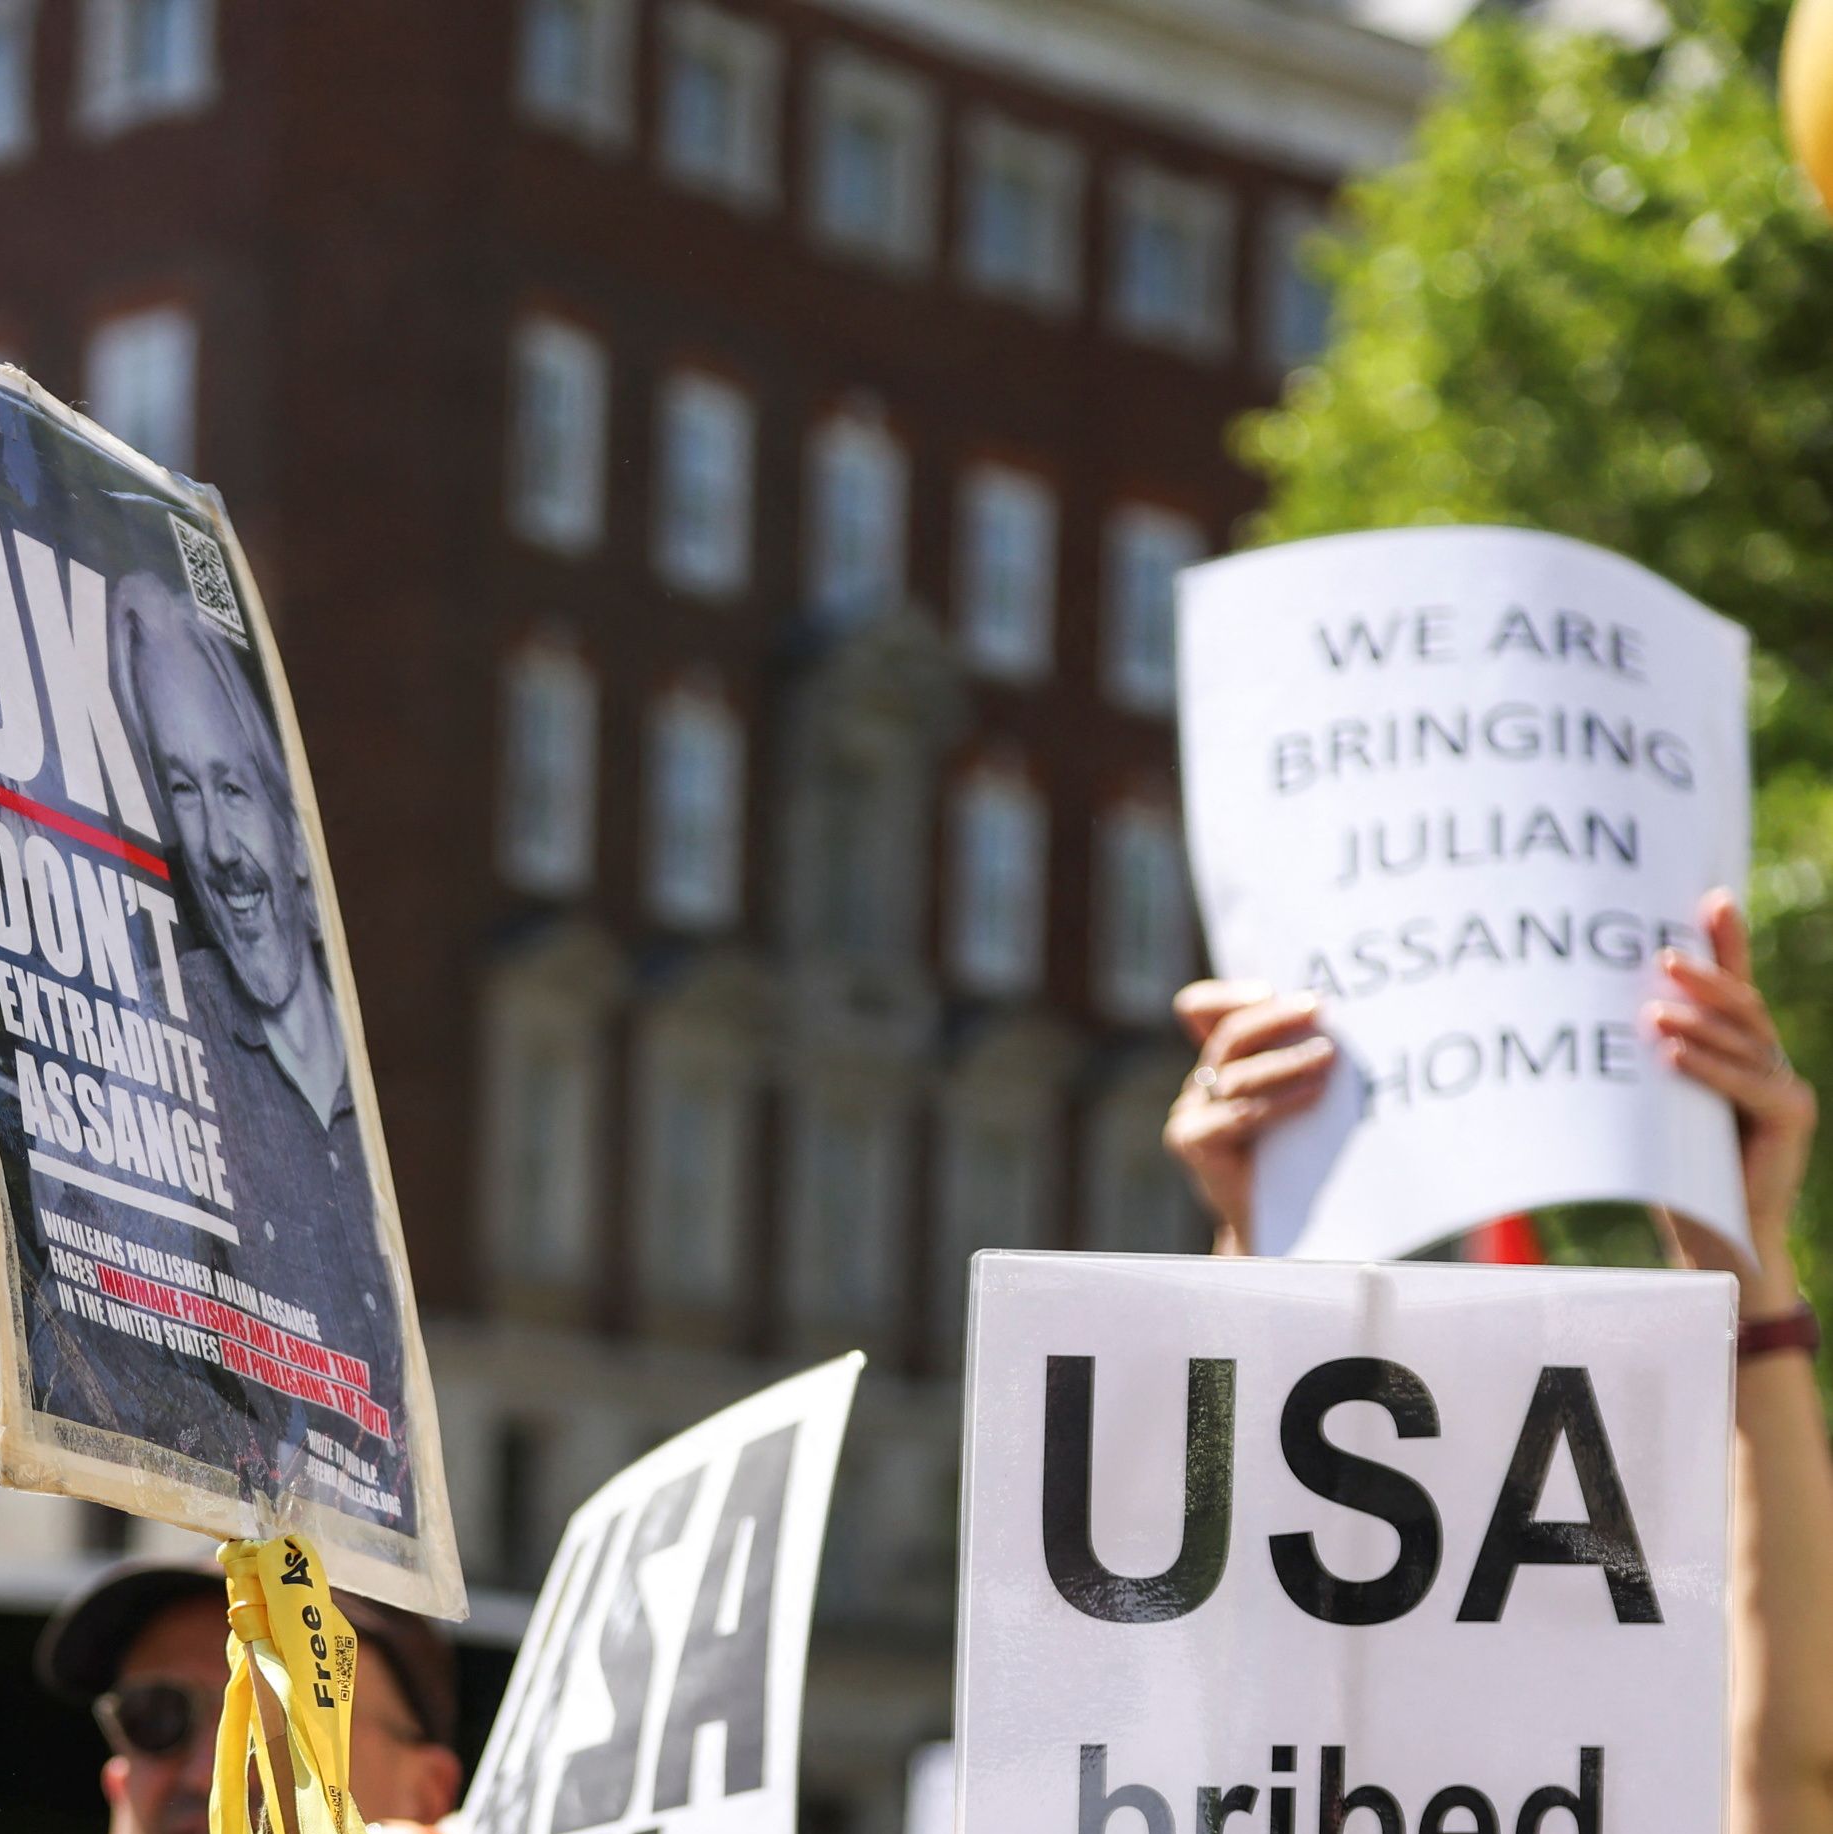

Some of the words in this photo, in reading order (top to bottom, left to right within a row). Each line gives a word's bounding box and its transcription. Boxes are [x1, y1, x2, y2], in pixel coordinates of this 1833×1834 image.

[1315, 604, 1459, 670] WE
[1485, 607, 1649, 682] ARE
[1270, 702, 1696, 796] BRINGING
[1336, 805, 1643, 887] JULIAN
[1365, 1021, 1643, 1114] HOME
[15, 1050, 233, 1211] ASSANGE
[40, 1208, 126, 1268] WIKILEAKS
[126, 1240, 215, 1295] PUBLISHER
[214, 1271, 264, 1316] JULIAN
[259, 1290, 322, 1341] ASSANGE
[48, 1245, 98, 1288] FACES
[97, 1263, 182, 1318] INHUMANE
[182, 1292, 249, 1342] PRISONS
[248, 1318, 276, 1355] AND
[286, 1333, 331, 1375] SHOW
[330, 1351, 370, 1393] TRIAL
[56, 1281, 78, 1313] IN
[77, 1289, 108, 1326] THE
[107, 1299, 163, 1346] UNITED
[162, 1321, 221, 1365] STATES
[220, 1338, 250, 1375] FOR
[249, 1350, 333, 1406] PUBLISHING
[331, 1384, 359, 1421] THE
[357, 1393, 390, 1439] TRUTH
[1042, 1355, 1664, 1626] USA
[301, 1604, 335, 1708] Free
